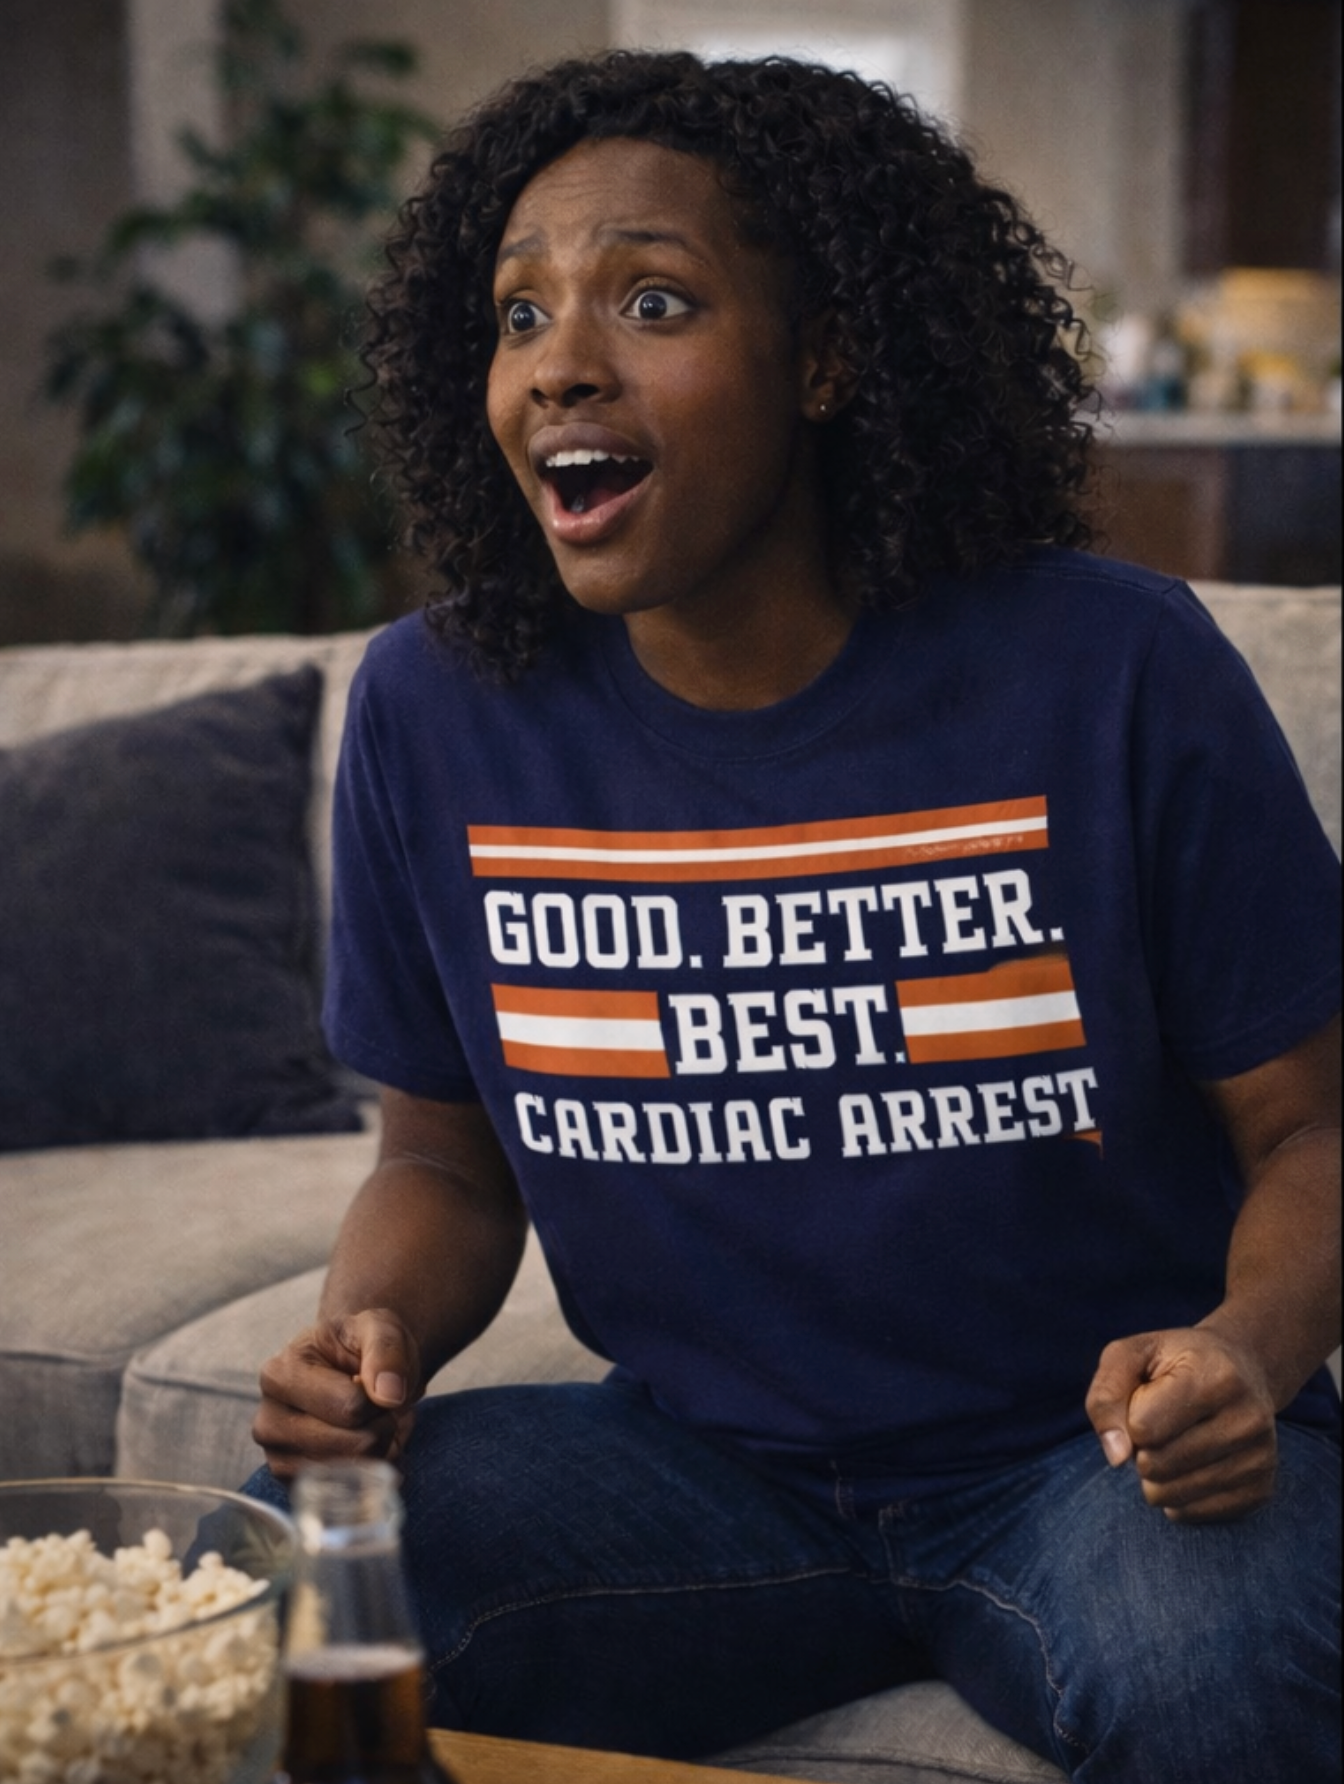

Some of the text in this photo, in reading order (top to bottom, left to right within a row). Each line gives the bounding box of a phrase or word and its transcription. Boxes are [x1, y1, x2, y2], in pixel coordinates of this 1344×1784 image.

[483, 868, 1065, 970] GOOD. BETTER.
[667, 984, 907, 1076] BEST.
[514, 1067, 1099, 1165] CARDIAC ARREST
